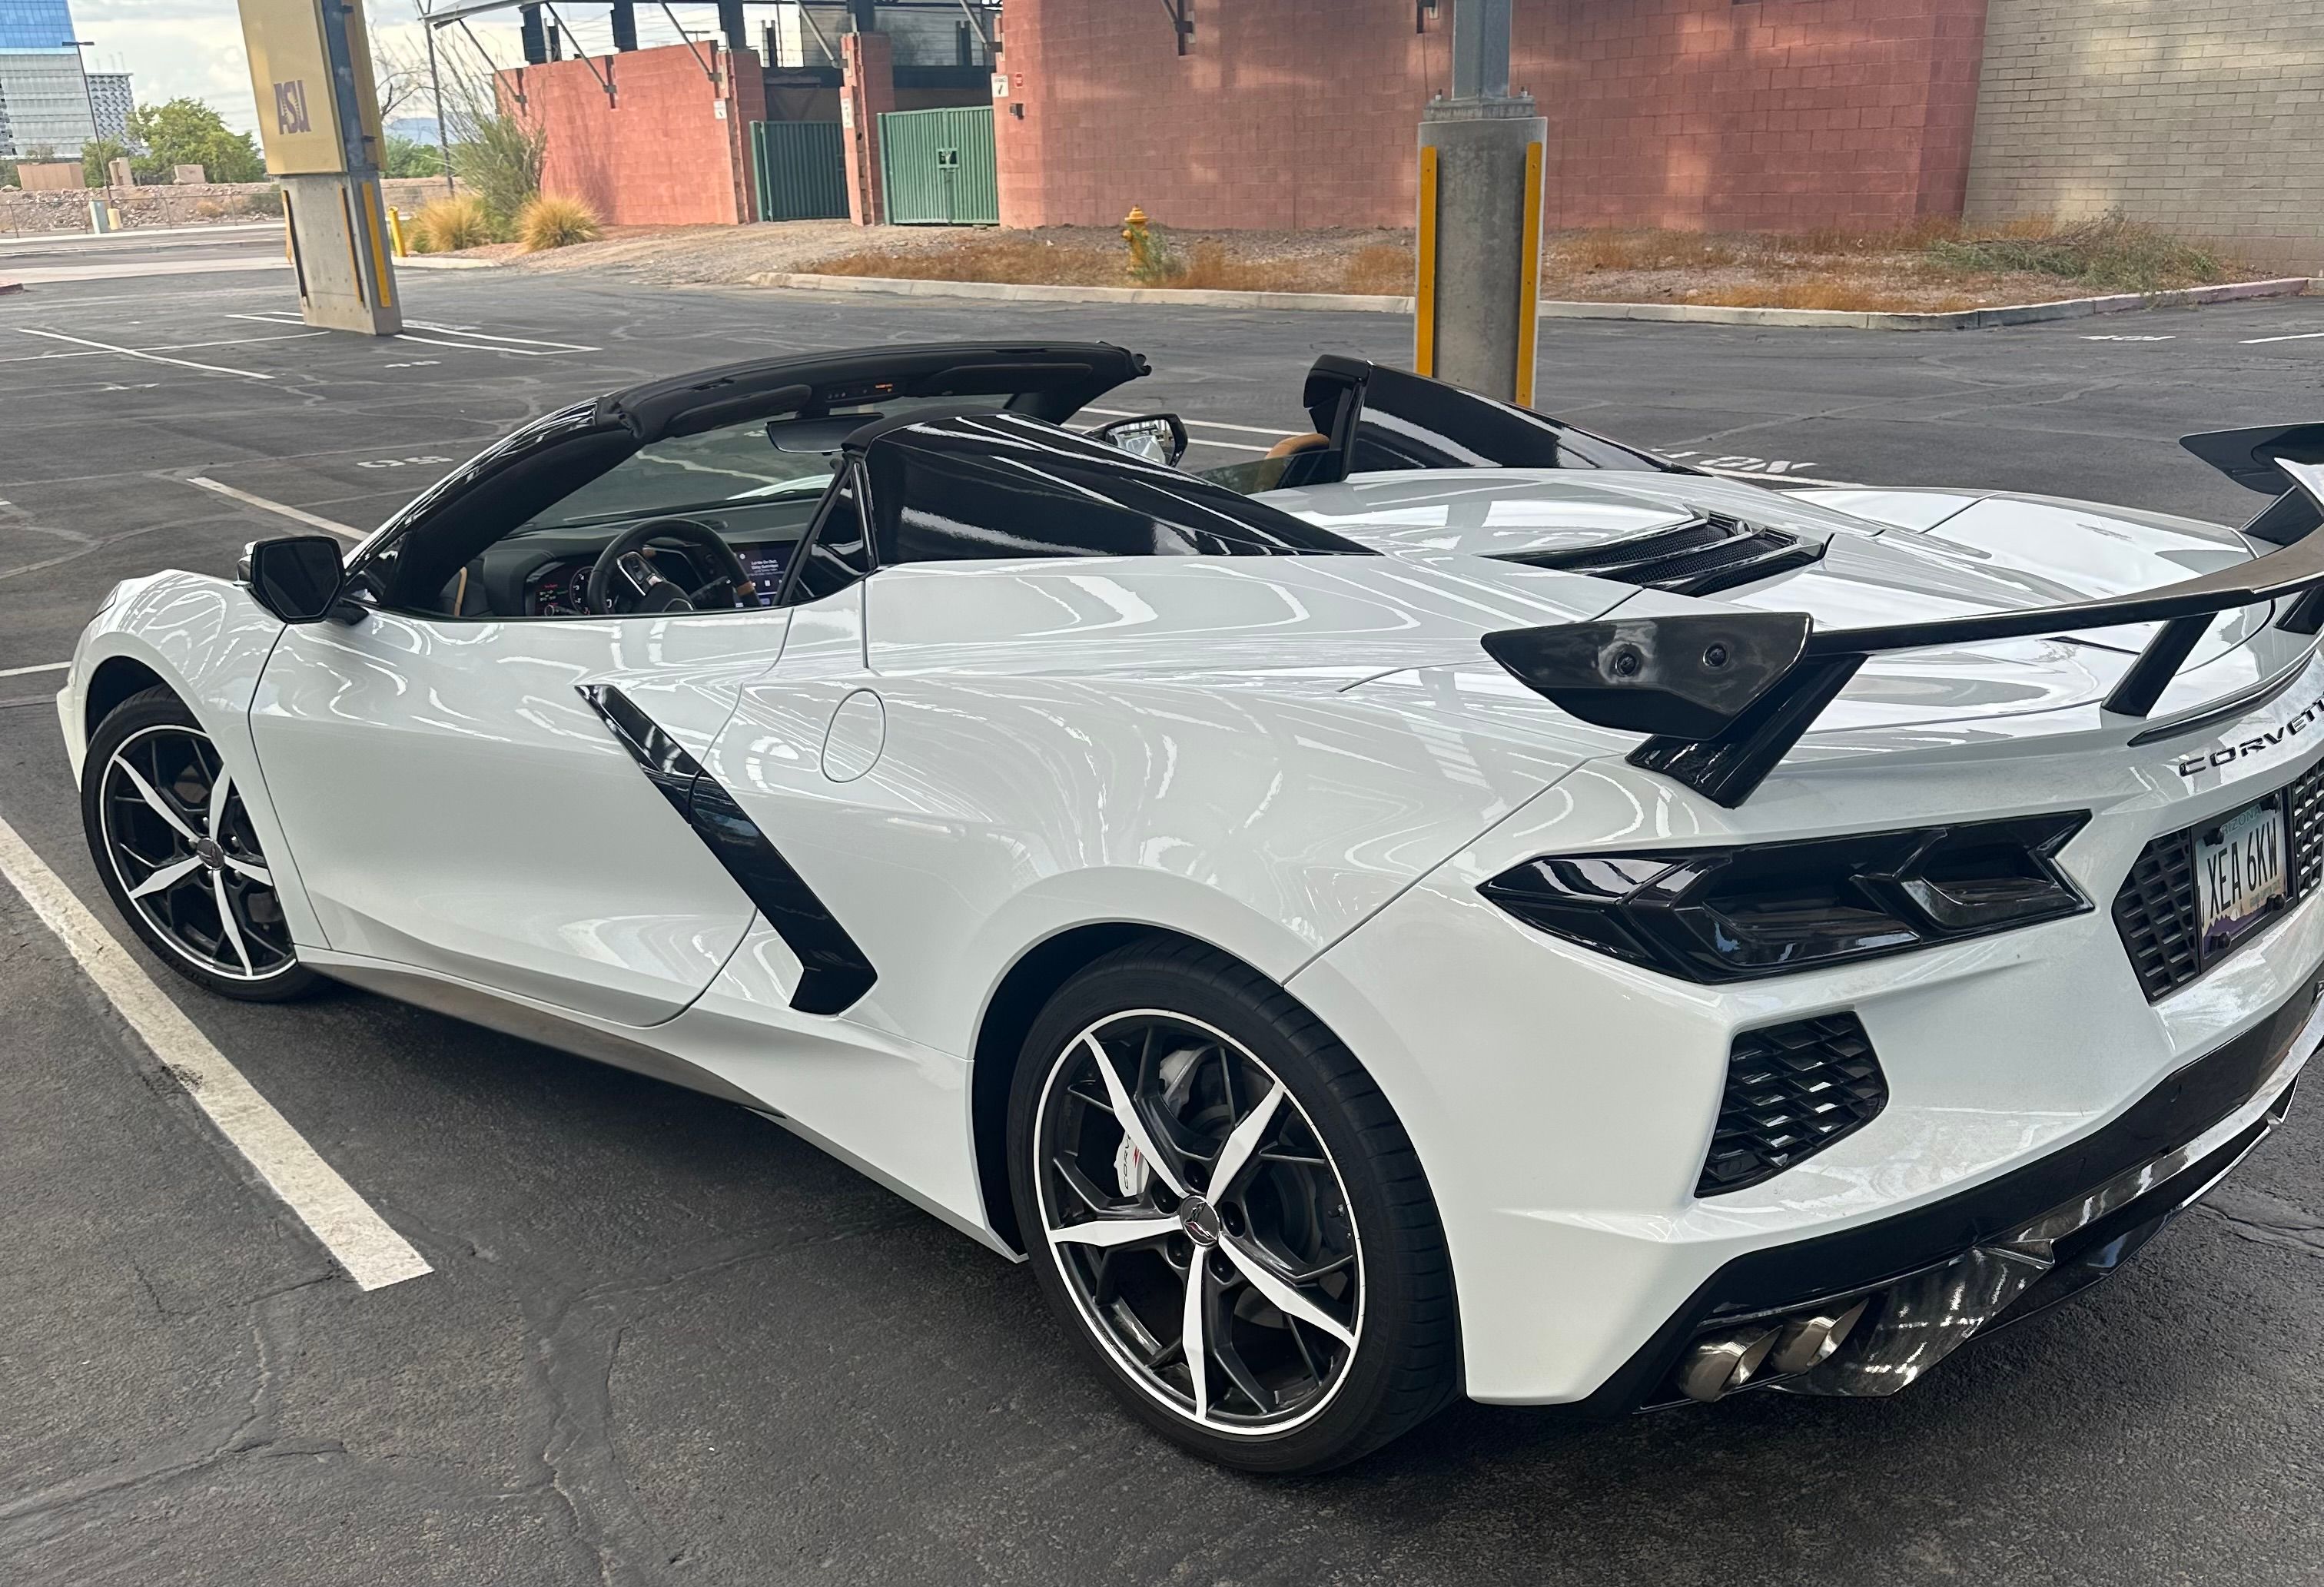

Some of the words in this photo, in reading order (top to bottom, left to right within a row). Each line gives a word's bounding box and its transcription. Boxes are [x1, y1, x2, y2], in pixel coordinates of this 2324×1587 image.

[274, 79, 311, 135] ASU
[2220, 804, 2263, 835] RIZONA
[2207, 842, 2242, 919] XEA
[2247, 817, 2277, 892] 6KW
